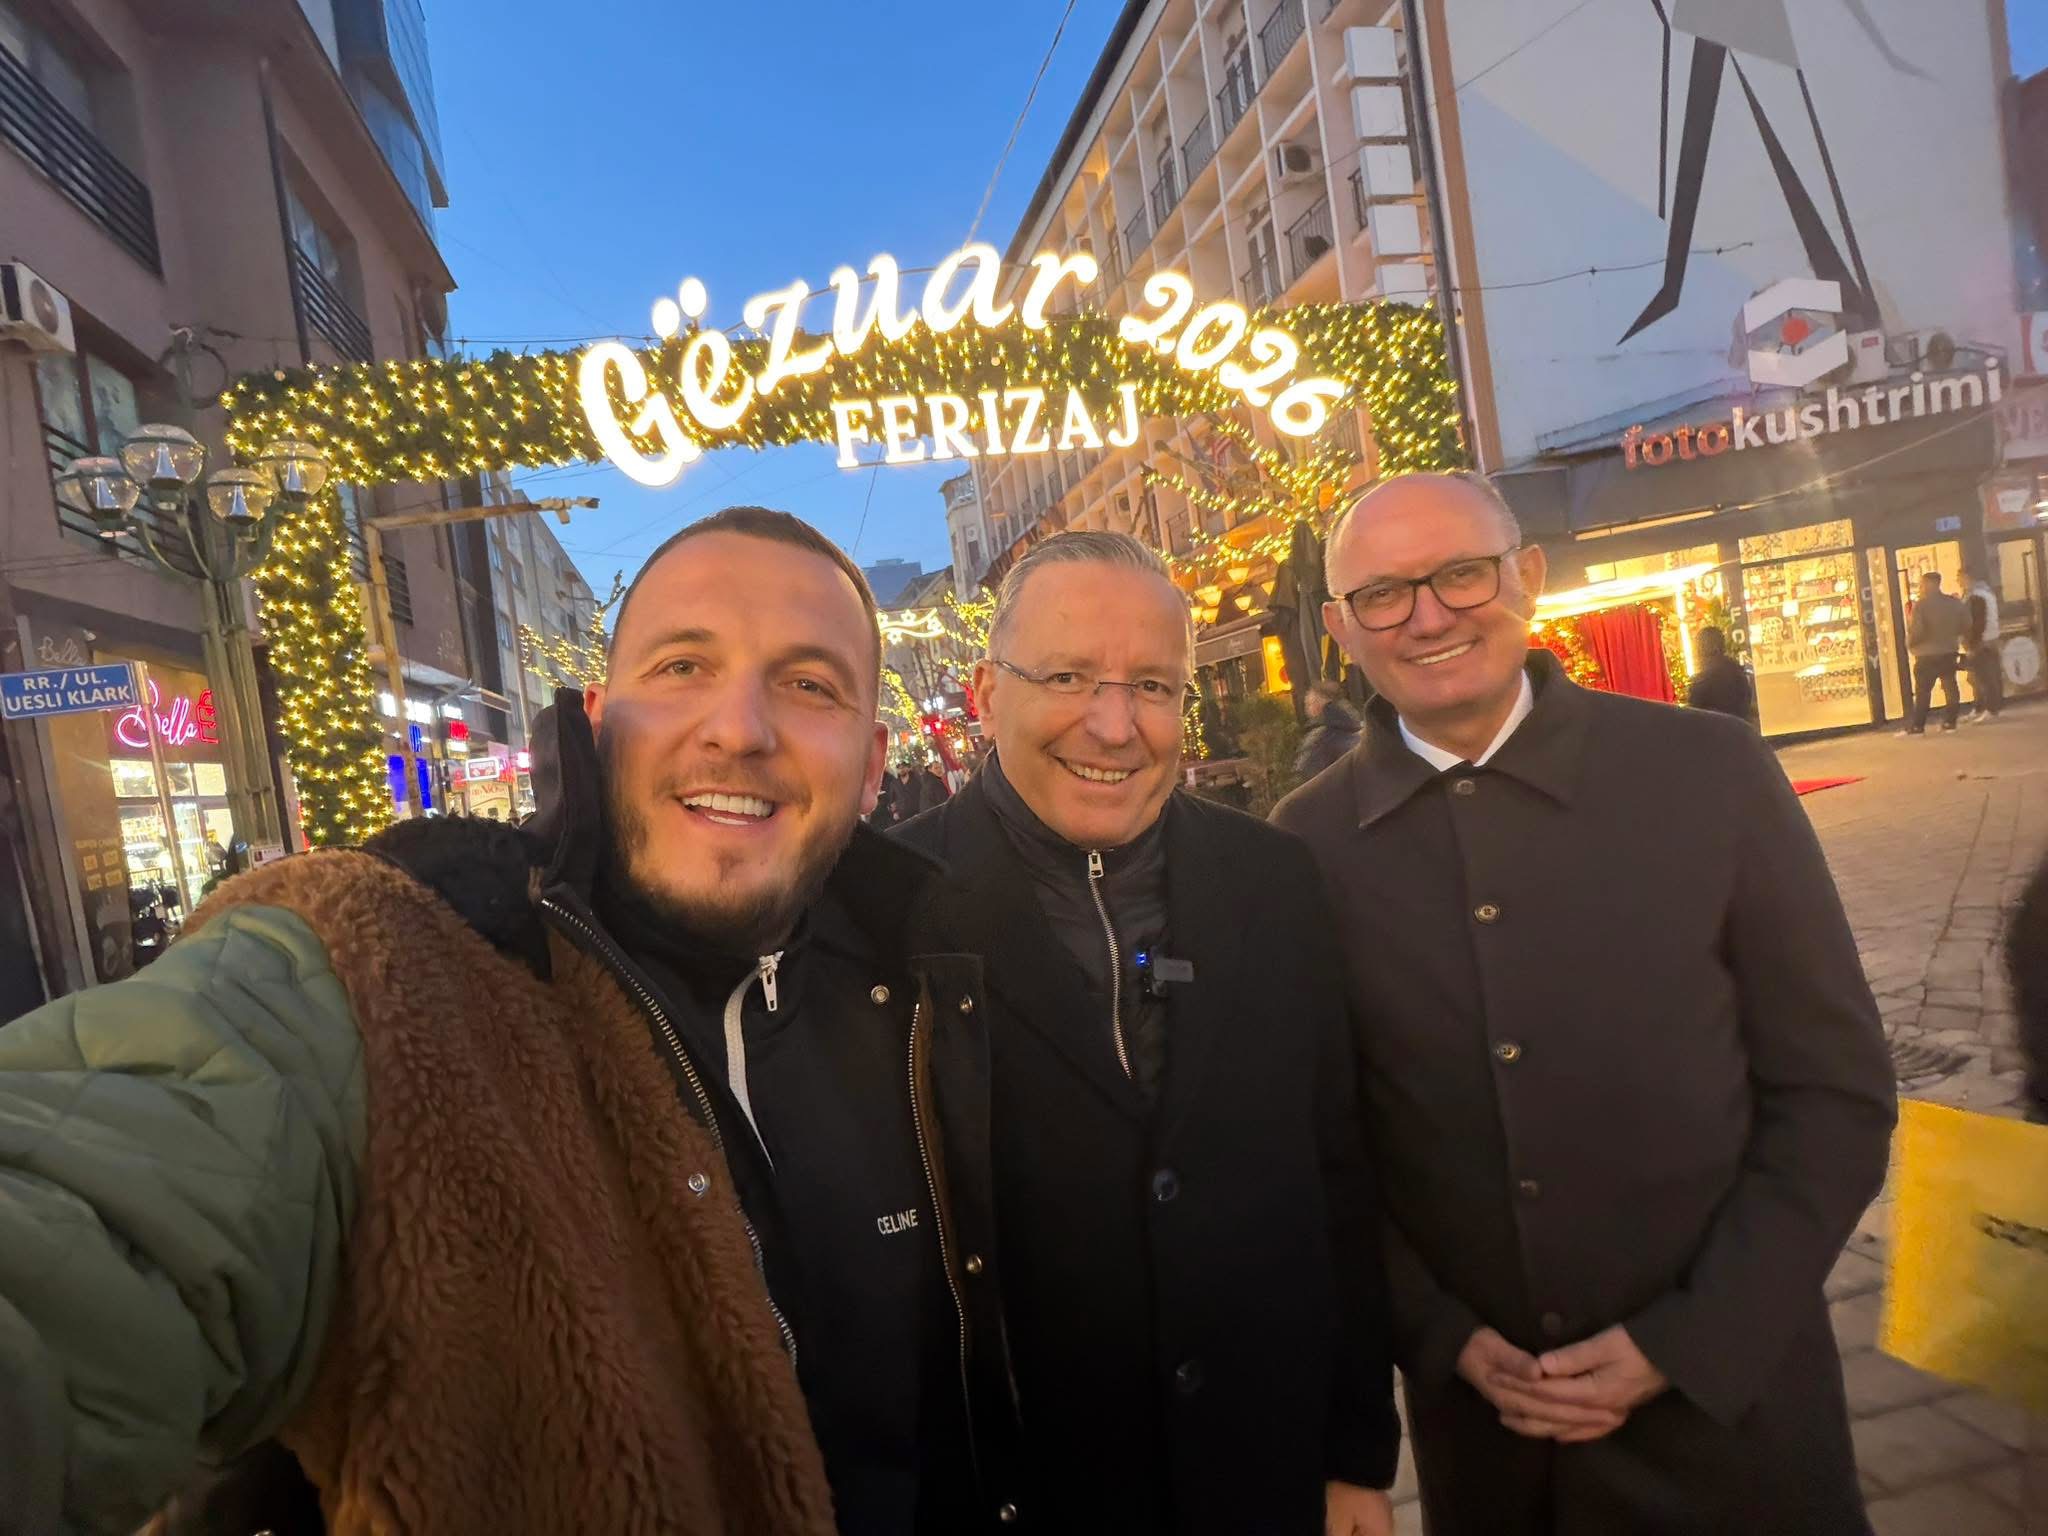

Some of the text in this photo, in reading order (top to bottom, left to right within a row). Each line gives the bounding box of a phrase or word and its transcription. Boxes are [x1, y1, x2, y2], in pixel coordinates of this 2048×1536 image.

[578, 242, 1346, 487] Gëzuar 2026
[830, 383, 1140, 469] FERIZAJ
[74, 670, 108, 687] UL.
[6, 684, 131, 713] UESLI KLARK
[877, 1208, 919, 1235] CELINE
